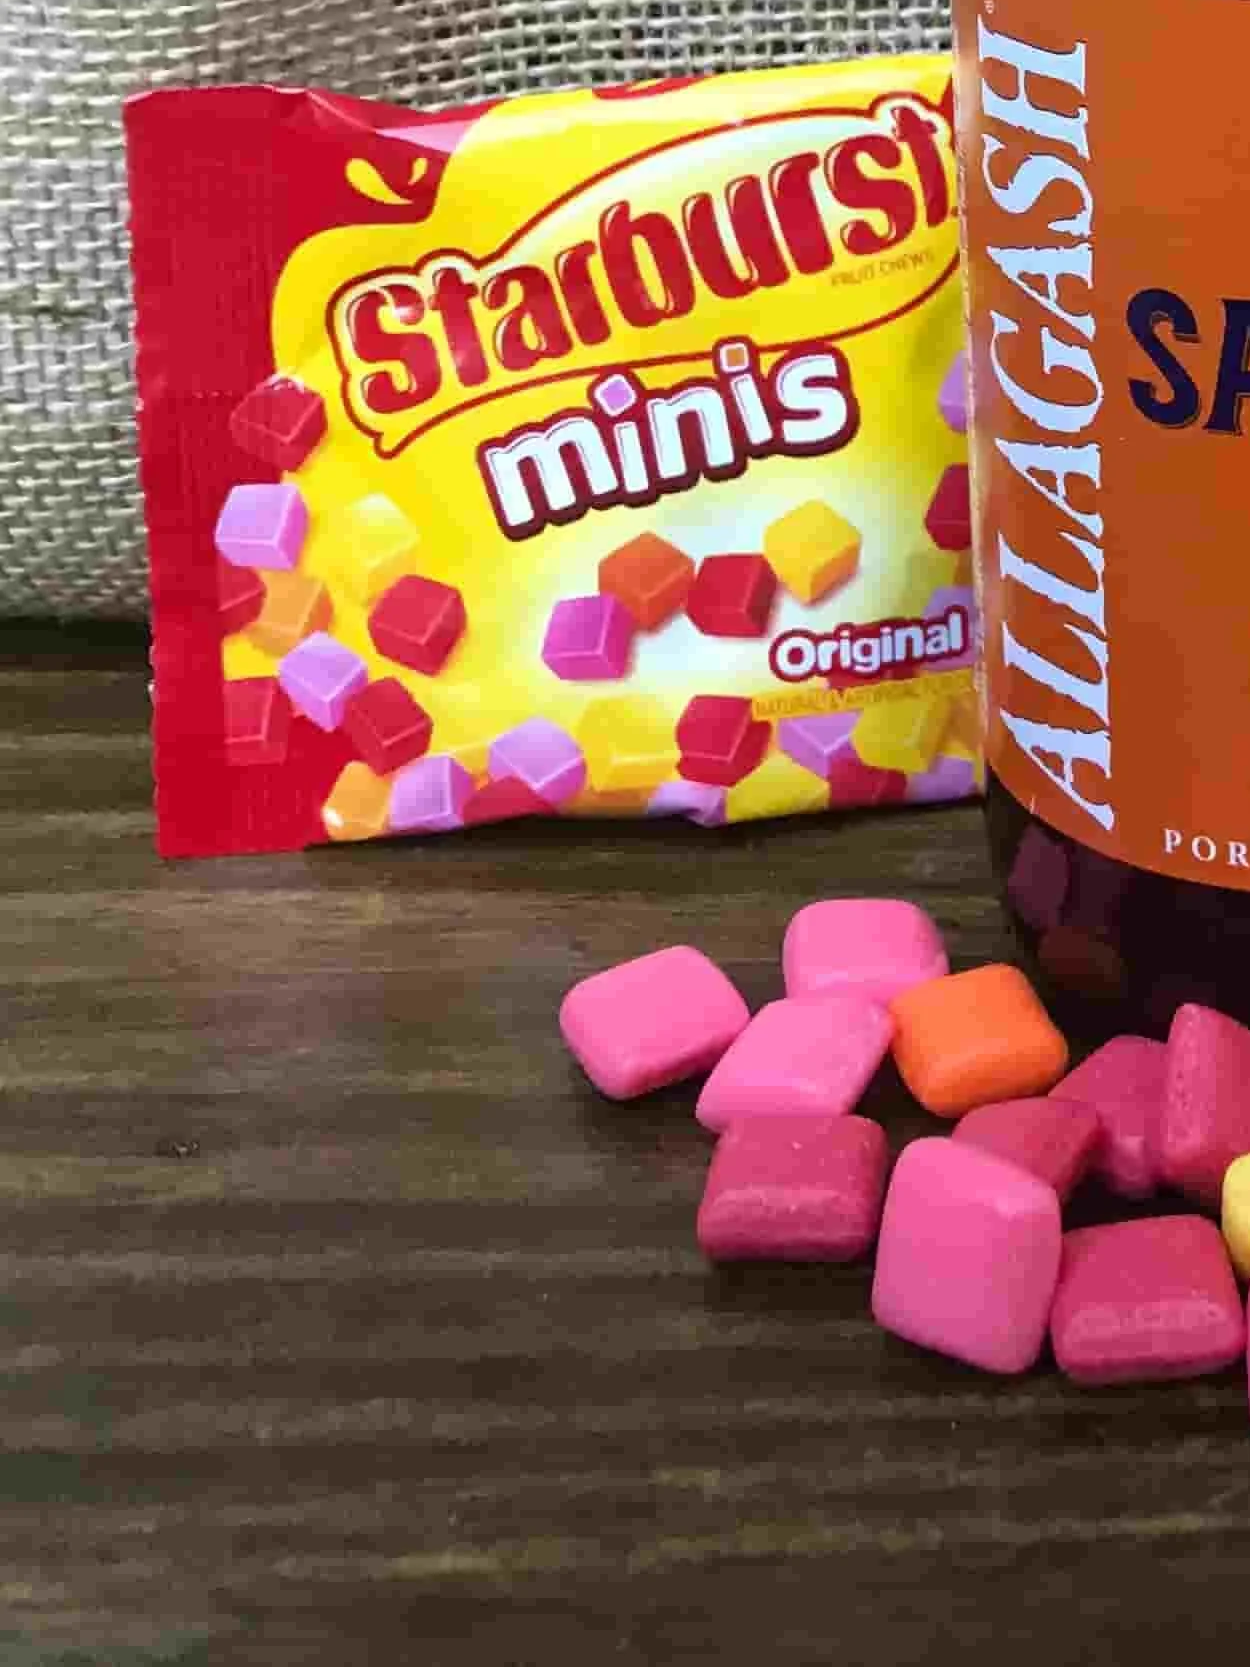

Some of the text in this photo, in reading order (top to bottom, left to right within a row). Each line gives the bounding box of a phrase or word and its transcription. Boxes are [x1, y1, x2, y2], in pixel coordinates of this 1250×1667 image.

[345, 105, 948, 415] Starburst
[484, 338, 848, 528] minis
[977, 14, 1115, 832] ALLAGASH
[776, 611, 963, 675] Original
